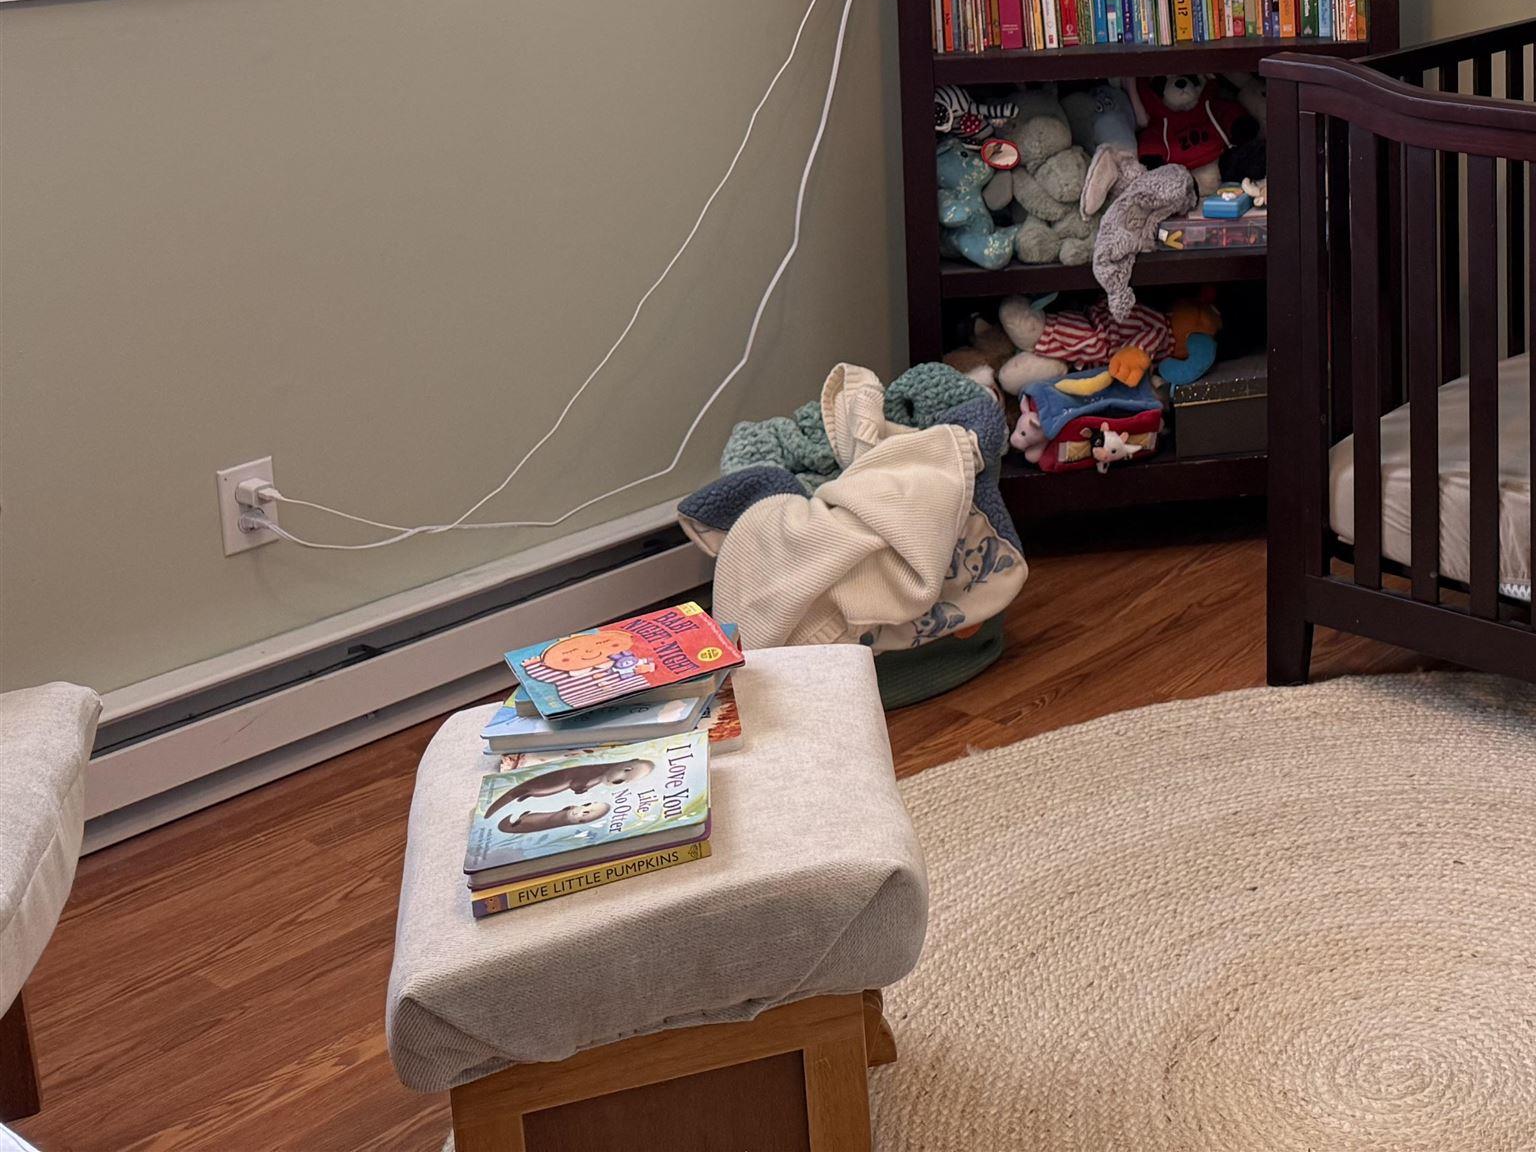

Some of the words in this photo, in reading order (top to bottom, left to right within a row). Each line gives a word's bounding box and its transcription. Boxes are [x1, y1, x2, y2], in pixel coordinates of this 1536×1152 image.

[1178, 6, 1188, 17] I?
[655, 611, 700, 634] BABY
[666, 743, 692, 753] I
[664, 753, 694, 788] Love
[611, 788, 632, 804] No
[636, 788, 658, 814] Like
[662, 787, 689, 819] You
[608, 804, 632, 833] Otter
[518, 883, 549, 903] FIVE
[553, 870, 601, 894] LITTLE
[606, 851, 680, 878] PUMPKINS
